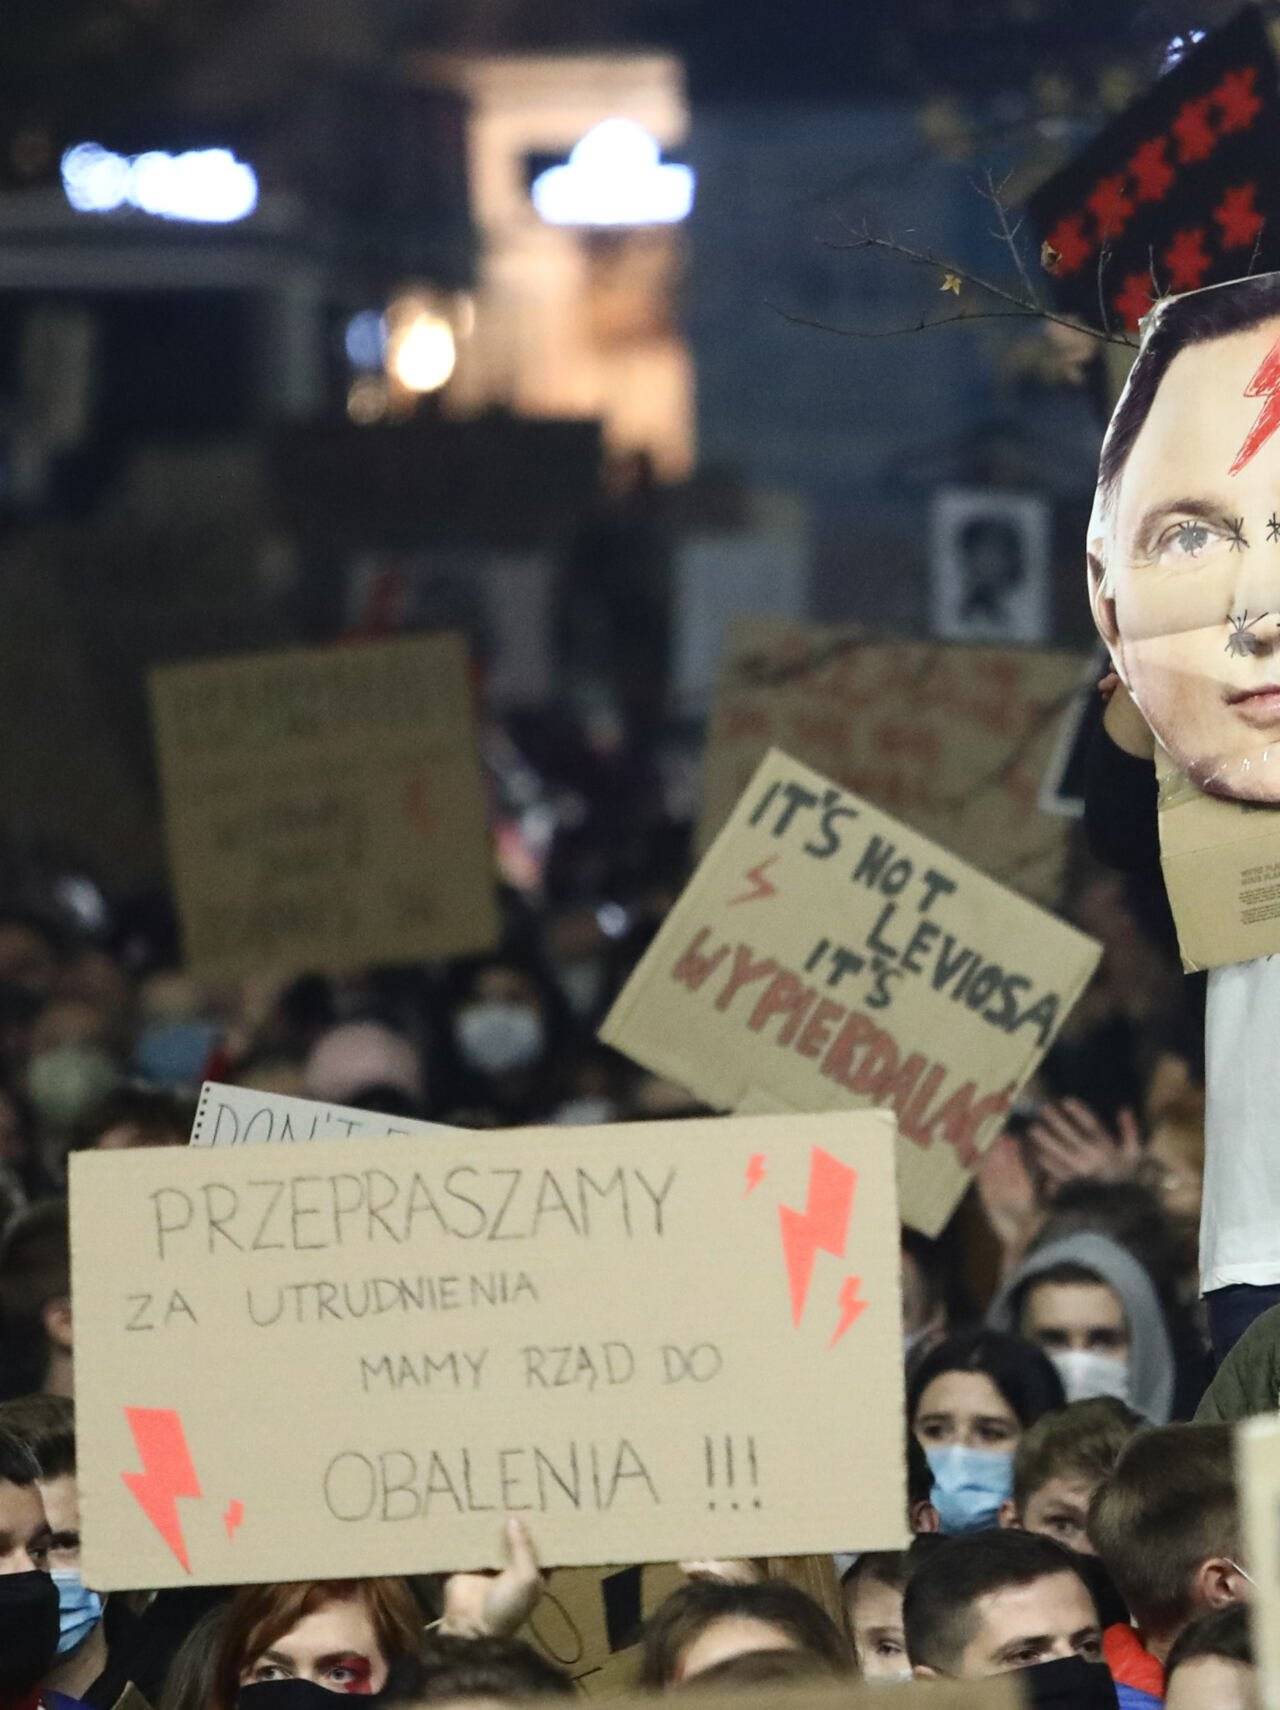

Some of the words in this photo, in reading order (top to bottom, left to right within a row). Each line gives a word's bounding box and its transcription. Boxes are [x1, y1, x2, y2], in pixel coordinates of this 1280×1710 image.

[749, 781, 858, 860] IT'S
[852, 834, 958, 912] NOT
[803, 938, 905, 1010] IT'S
[865, 901, 1061, 1048] LEVIOSA
[149, 1164, 678, 1261] PRZEPRASZAMY
[123, 1289, 198, 1332] ZA
[246, 1270, 542, 1328] UTRUDNIENIA
[360, 1347, 490, 1393] MAMY
[522, 1340, 635, 1393] RZĄD
[661, 1341, 723, 1386] DO
[322, 1435, 661, 1524] OBALENIA
[704, 1434, 763, 1511] !!!
